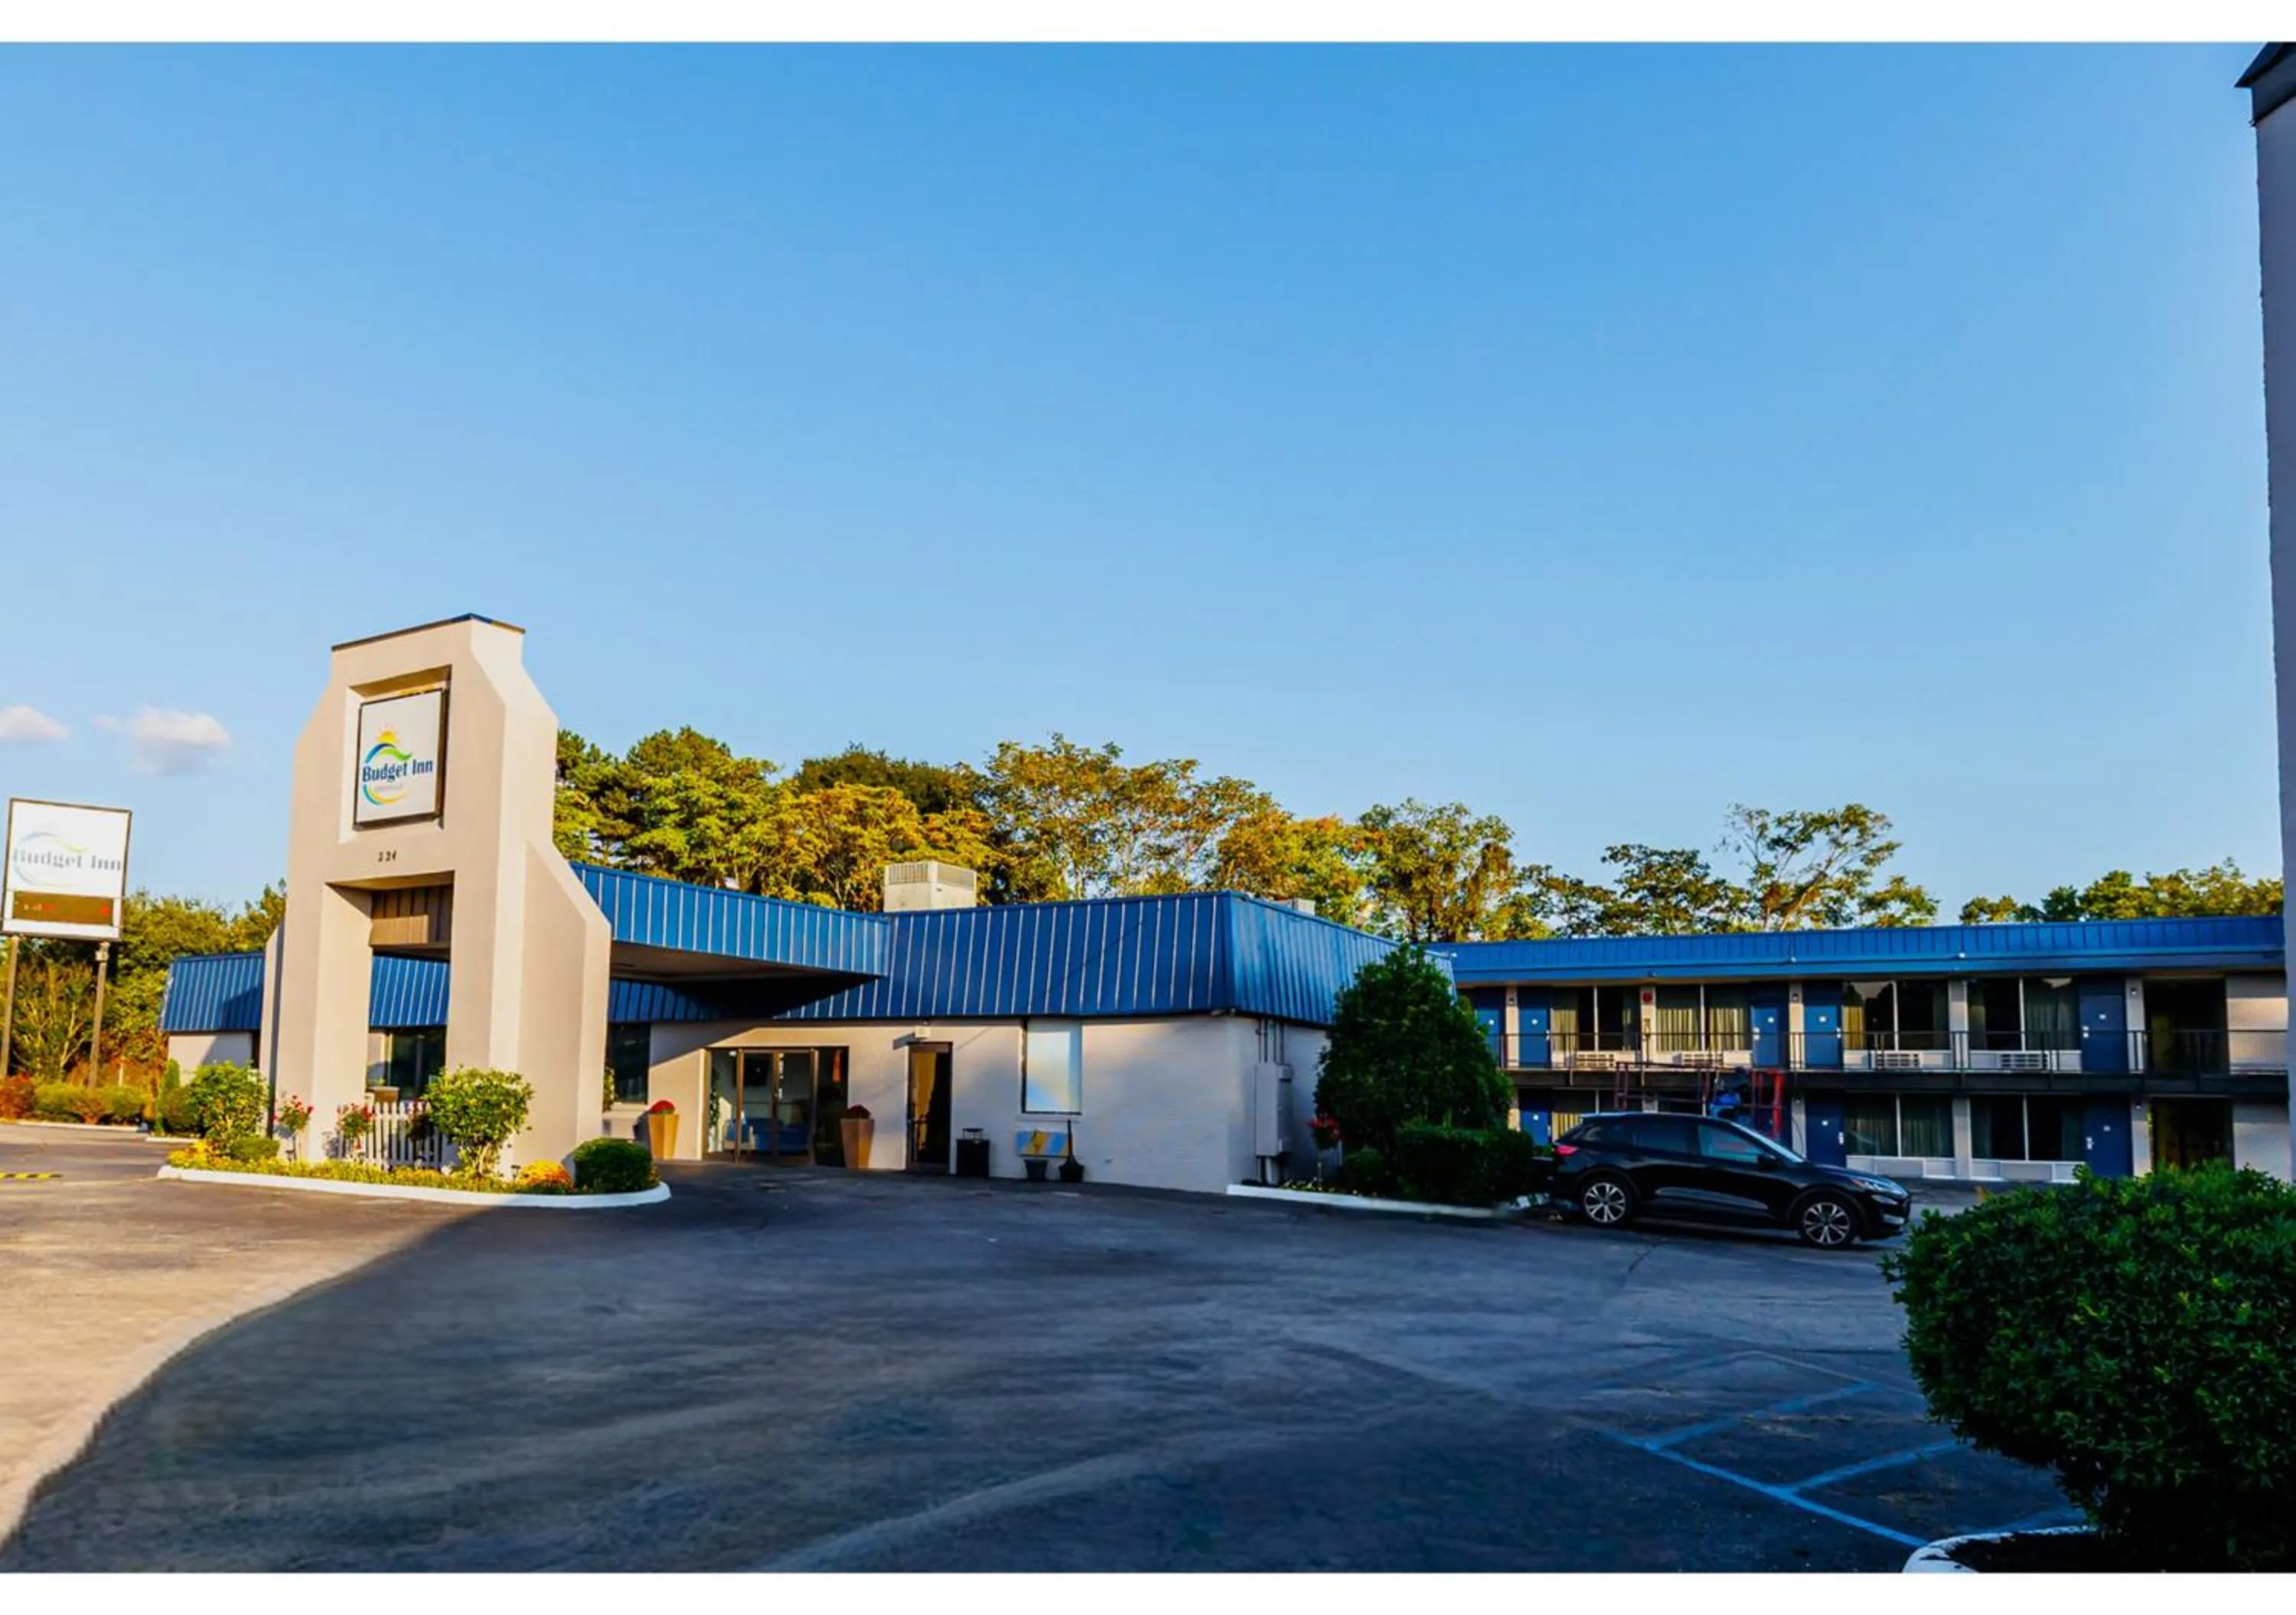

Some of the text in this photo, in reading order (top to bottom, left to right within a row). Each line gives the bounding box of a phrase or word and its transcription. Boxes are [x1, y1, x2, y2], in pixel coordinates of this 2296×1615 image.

[363, 759, 432, 782] Budget Inn
[13, 848, 121, 871] Budget Inn
